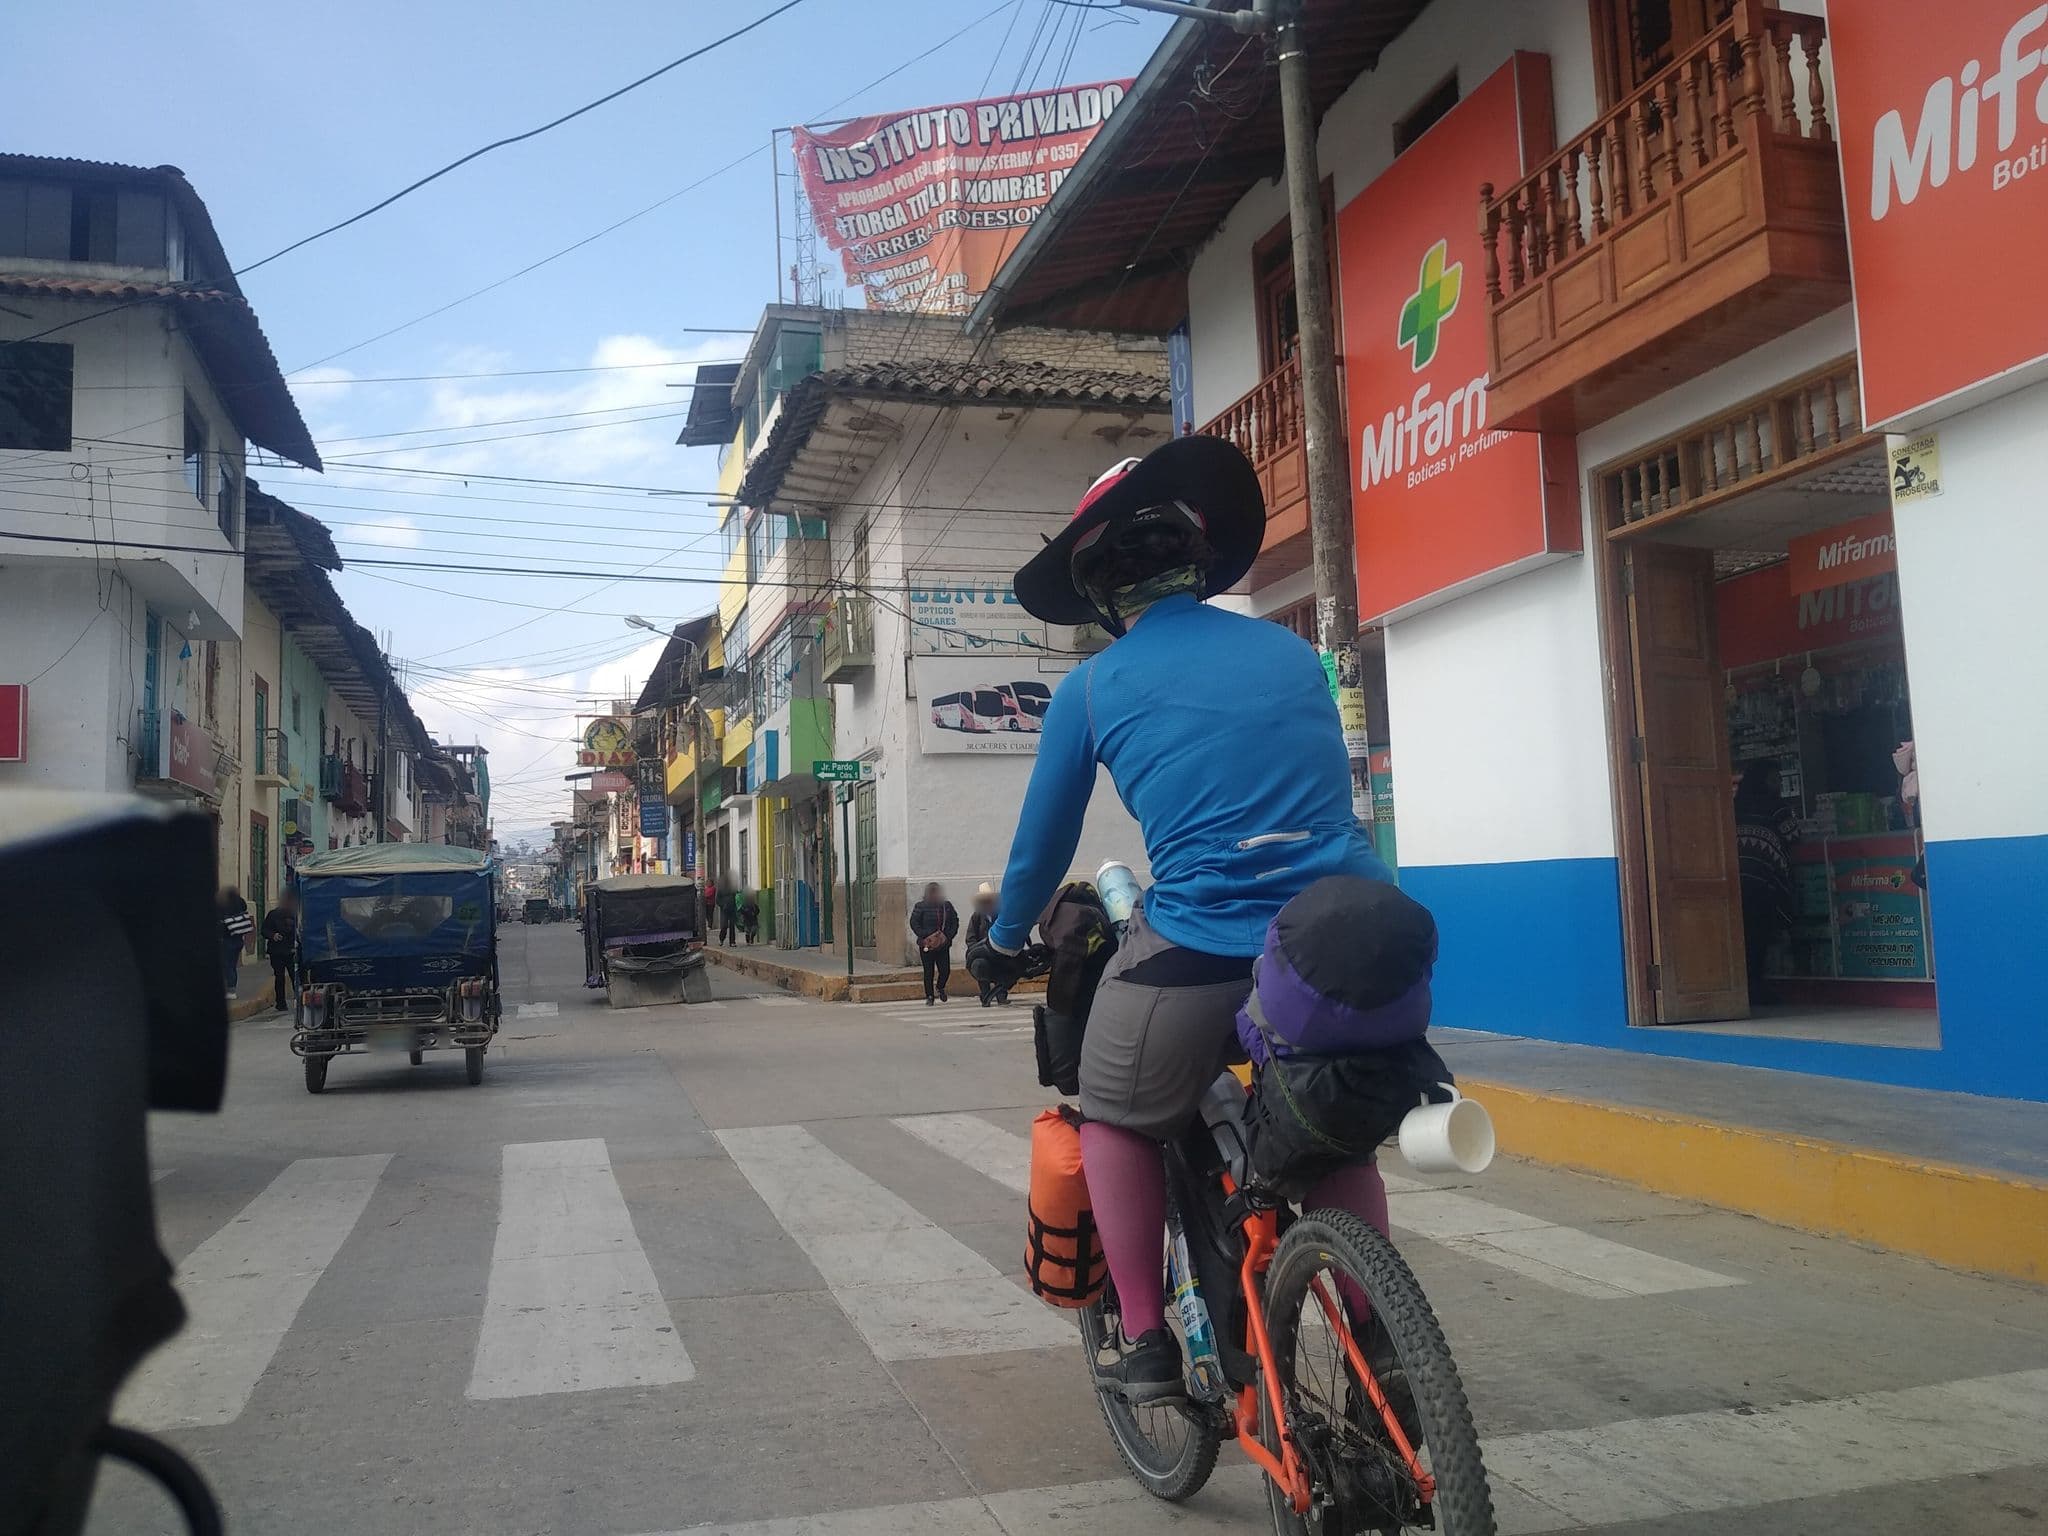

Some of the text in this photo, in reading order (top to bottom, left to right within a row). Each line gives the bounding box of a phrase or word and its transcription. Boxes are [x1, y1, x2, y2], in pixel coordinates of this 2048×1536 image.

[1871, 3, 2048, 221] Mif
[815, 83, 1126, 183] INSTITUTO PRIVADO
[837, 180, 894, 208] APROBADO
[894, 173, 914, 193] POR
[965, 152, 1032, 172] MINISTERIAL
[1050, 143, 1078, 161] 0357
[951, 178, 962, 202] A
[964, 173, 1046, 203] NOMBRE
[1891, 437, 1935, 459] CONECTADA
[1407, 456, 1447, 490] Boticas
[1449, 453, 1456, 471] y
[1895, 479, 1939, 499] PROSEGUR
[918, 606, 954, 615] OPTICOS
[919, 617, 957, 626] SOLARES
[821, 762, 853, 772] Jr. Pardo
